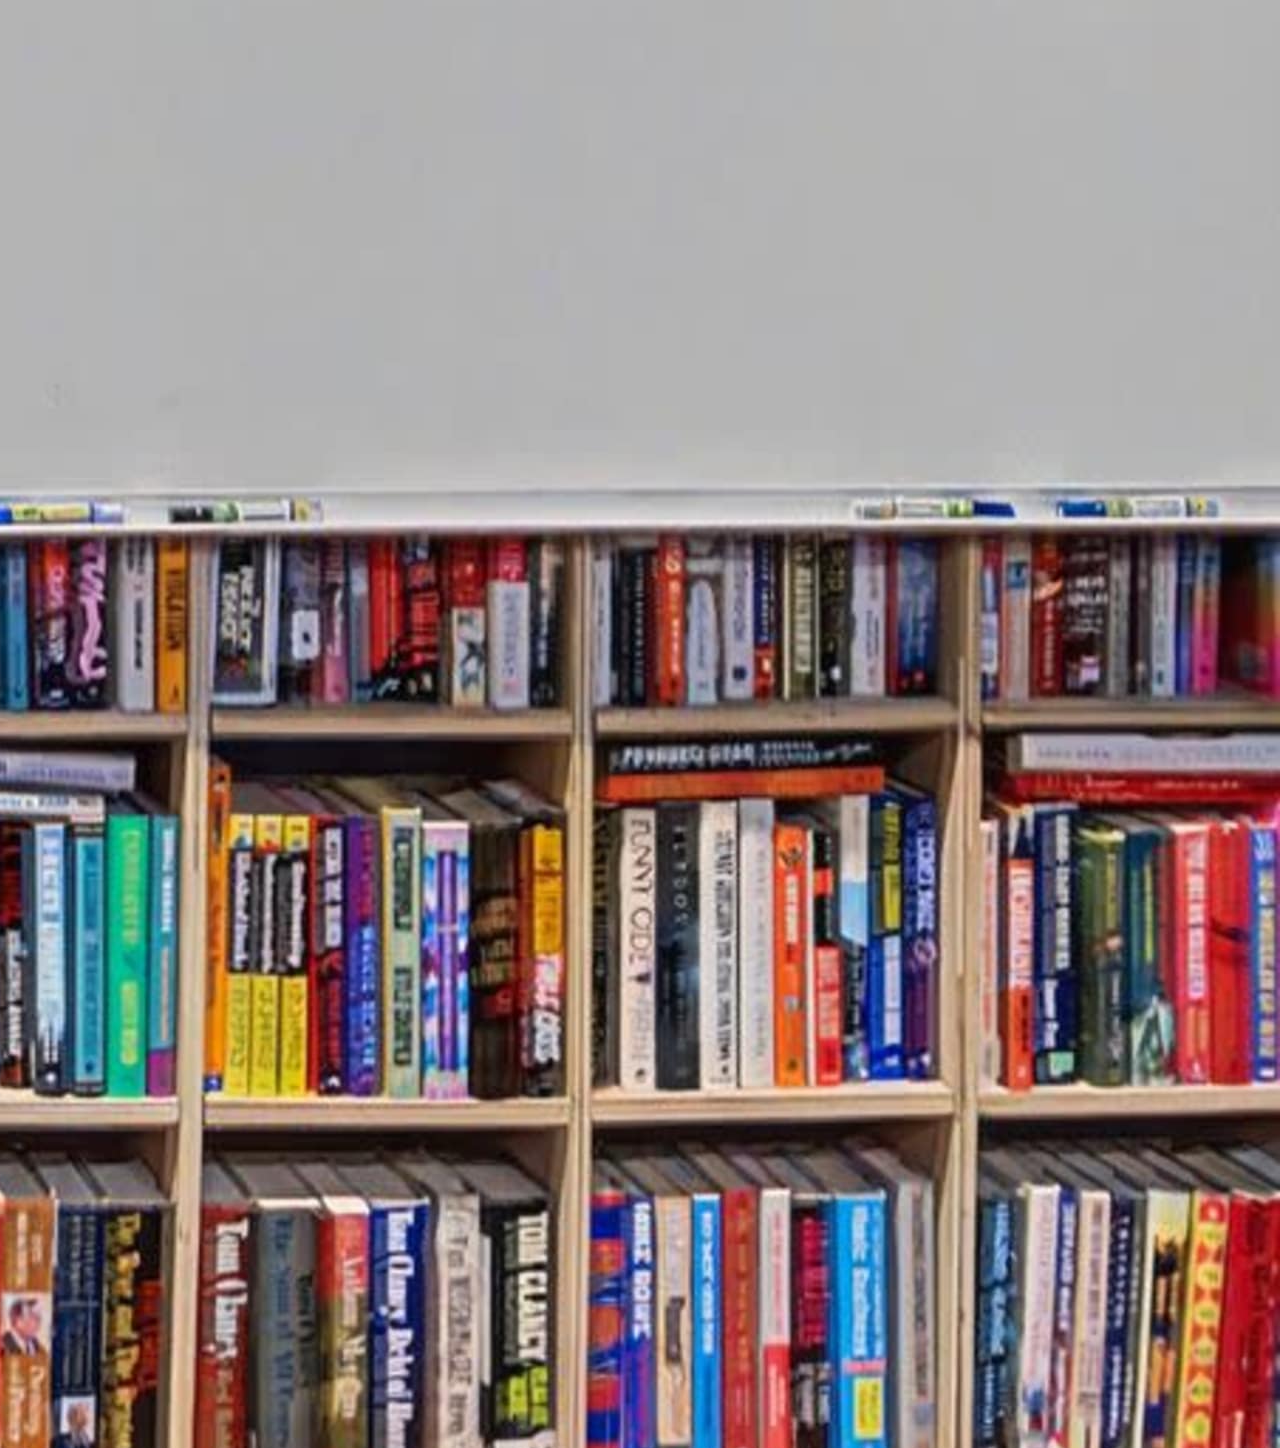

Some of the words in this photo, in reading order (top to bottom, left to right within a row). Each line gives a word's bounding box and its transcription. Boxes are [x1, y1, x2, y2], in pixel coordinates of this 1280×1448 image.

[630, 819, 653, 896] FUNNY
[215, 1218, 248, 1274] Tom
[387, 1210, 415, 1253] Tom
[517, 1210, 549, 1265] TOM
[378, 1255, 415, 1325] Clancy
[517, 1269, 549, 1363] CLANCY
